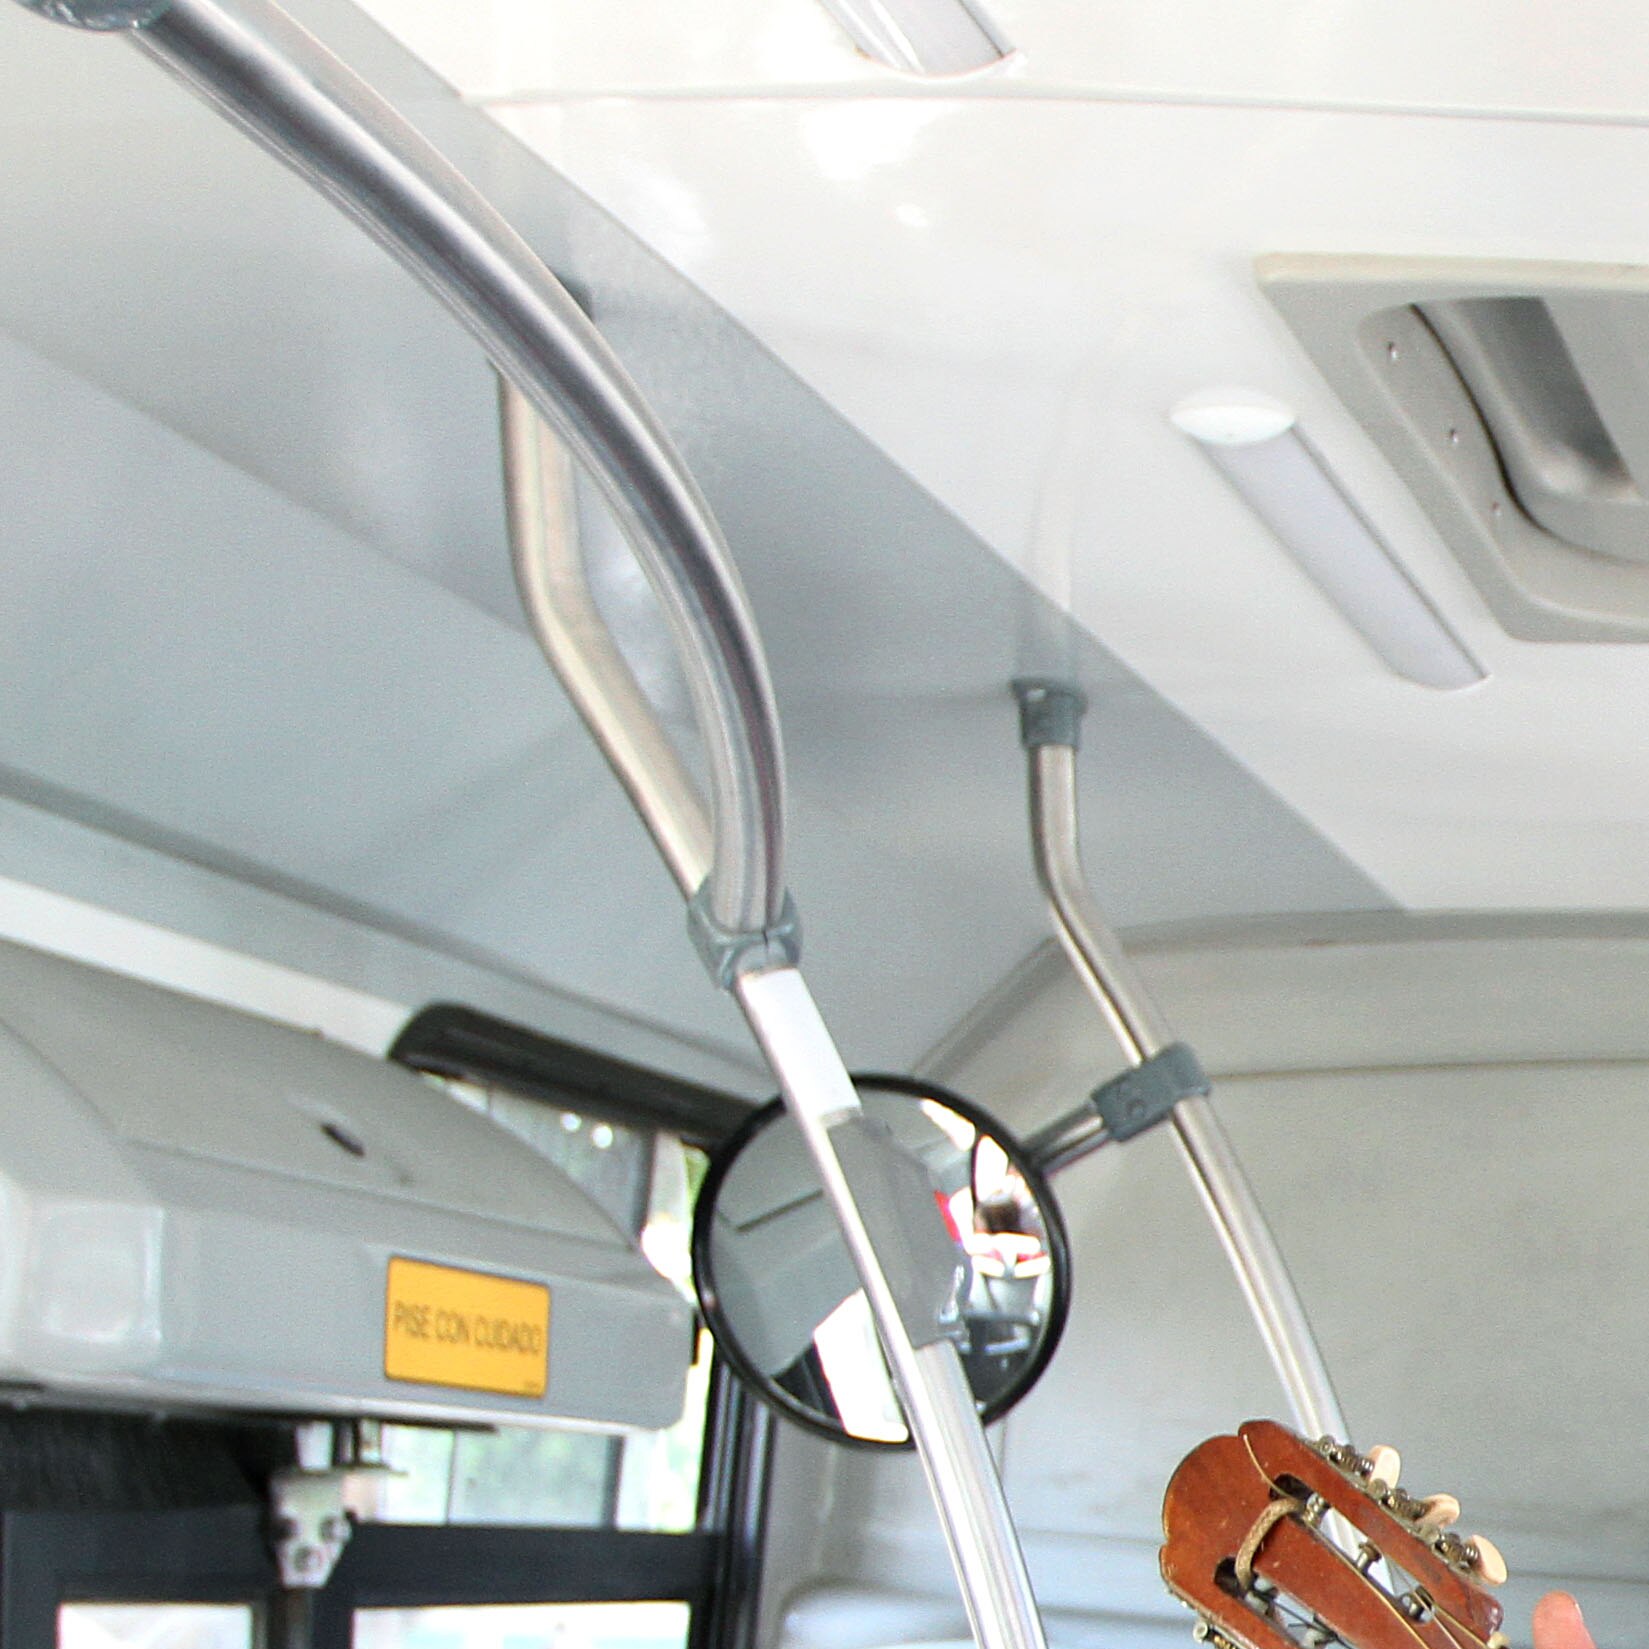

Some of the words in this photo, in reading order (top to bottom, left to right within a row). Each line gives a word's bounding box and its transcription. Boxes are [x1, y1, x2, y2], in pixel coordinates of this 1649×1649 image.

[394, 1301, 430, 1339] PISE
[436, 1309, 469, 1344] CON
[475, 1316, 542, 1355] CUIDADO
